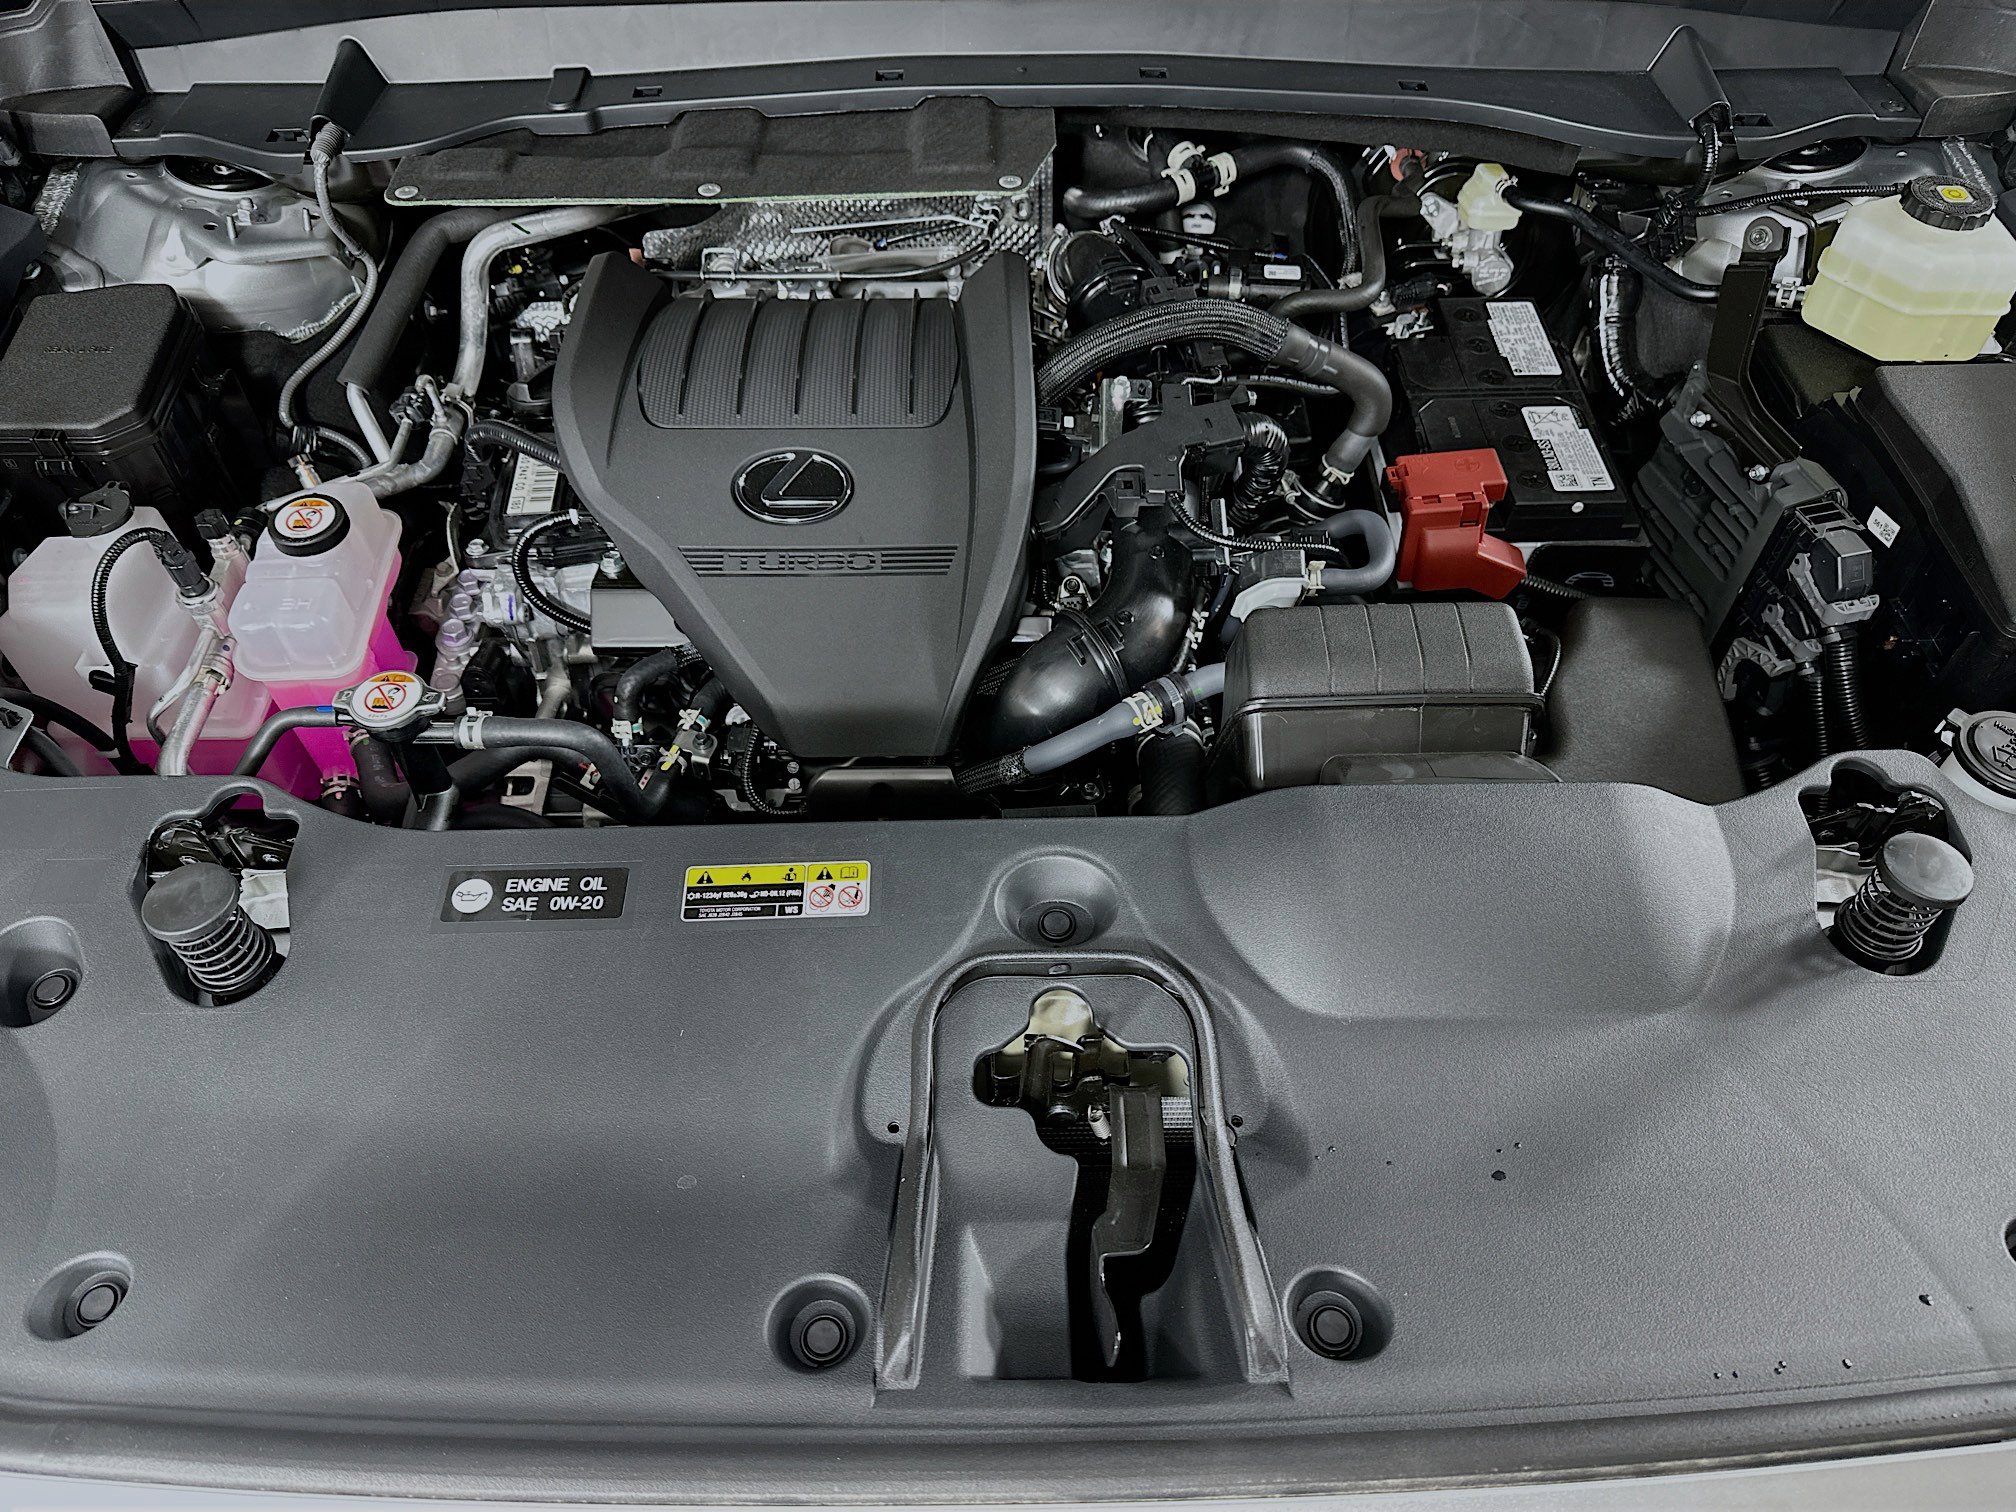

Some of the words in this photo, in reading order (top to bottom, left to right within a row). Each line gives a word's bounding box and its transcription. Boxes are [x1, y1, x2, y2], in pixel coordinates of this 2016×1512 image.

[727, 551, 877, 571] TURBO
[505, 877, 570, 893] ENGINE
[579, 876, 608, 891] OIL
[501, 897, 539, 912] SAE
[549, 895, 604, 911] 0W-20
[784, 906, 799, 914] WS
